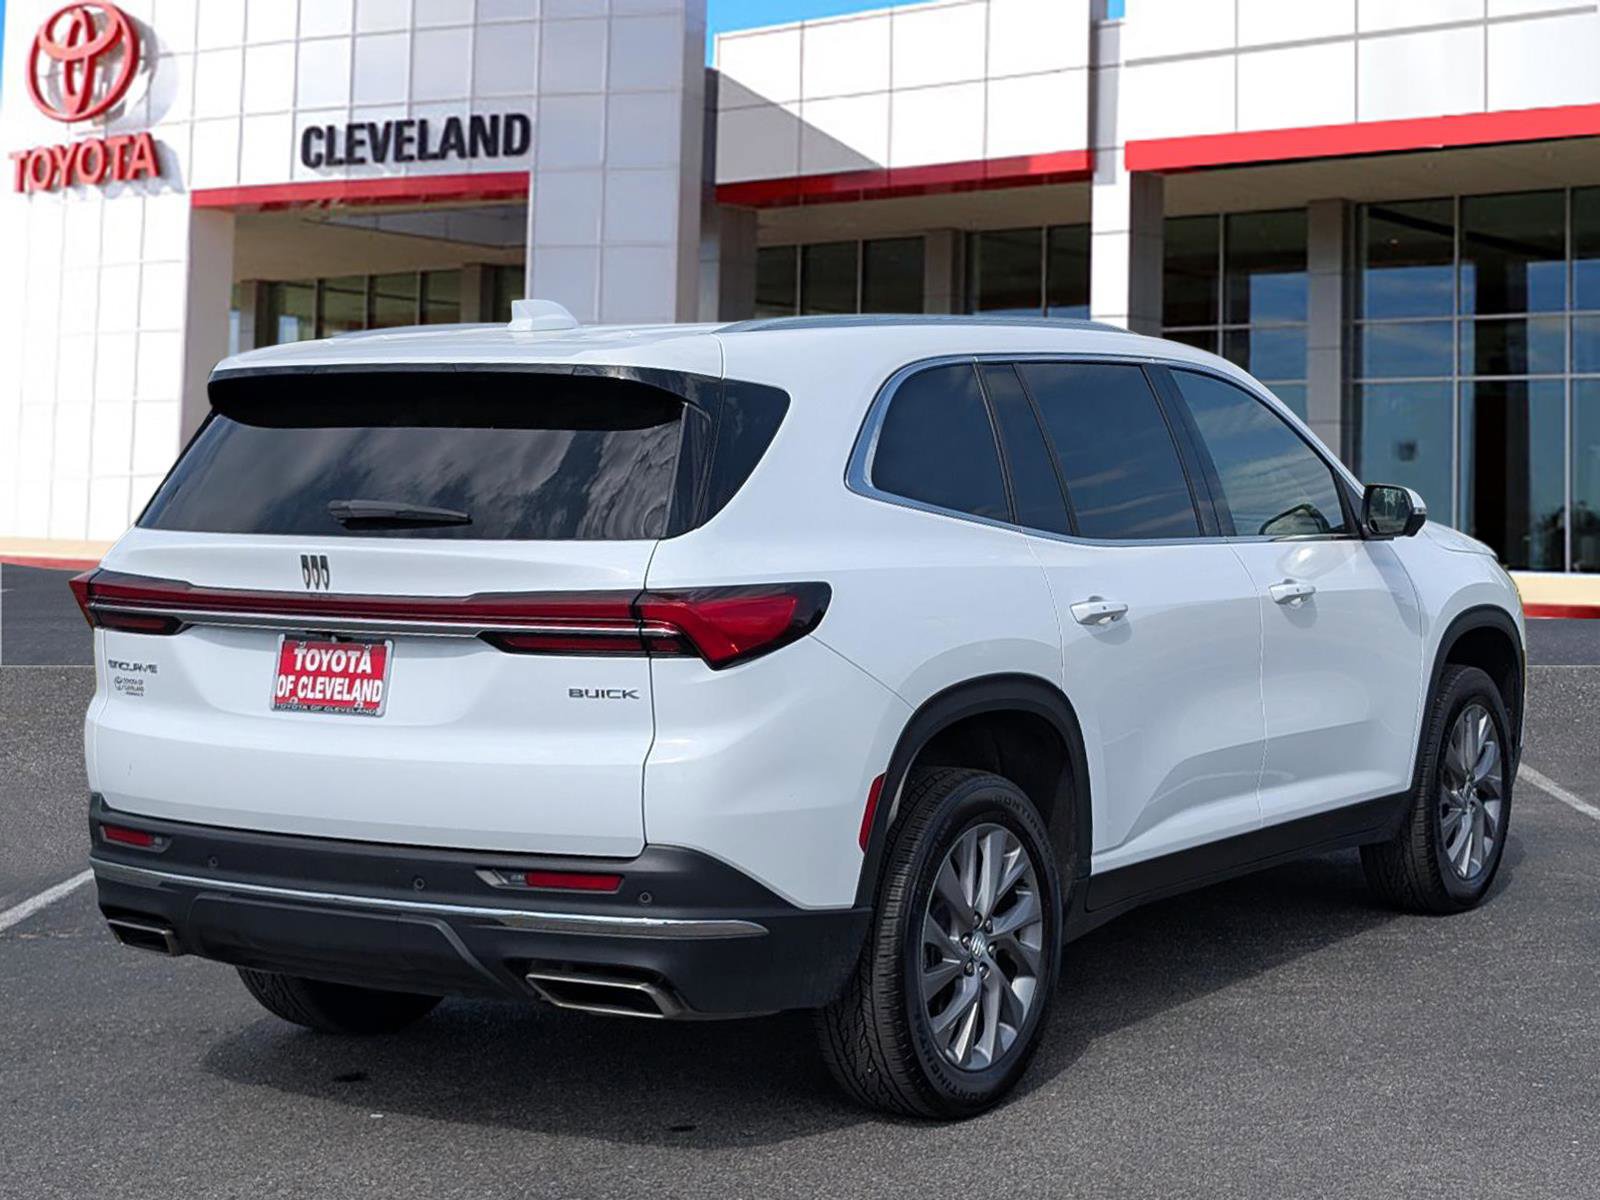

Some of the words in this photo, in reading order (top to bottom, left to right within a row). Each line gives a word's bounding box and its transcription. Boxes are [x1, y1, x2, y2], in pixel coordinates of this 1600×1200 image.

[301, 113, 531, 169] CLEVELAND
[10, 133, 161, 192] TOYOTA
[294, 647, 372, 673] TOYOTA
[277, 674, 295, 697] OF
[298, 676, 383, 703] CLEVELAND
[569, 688, 640, 699] BUICK
